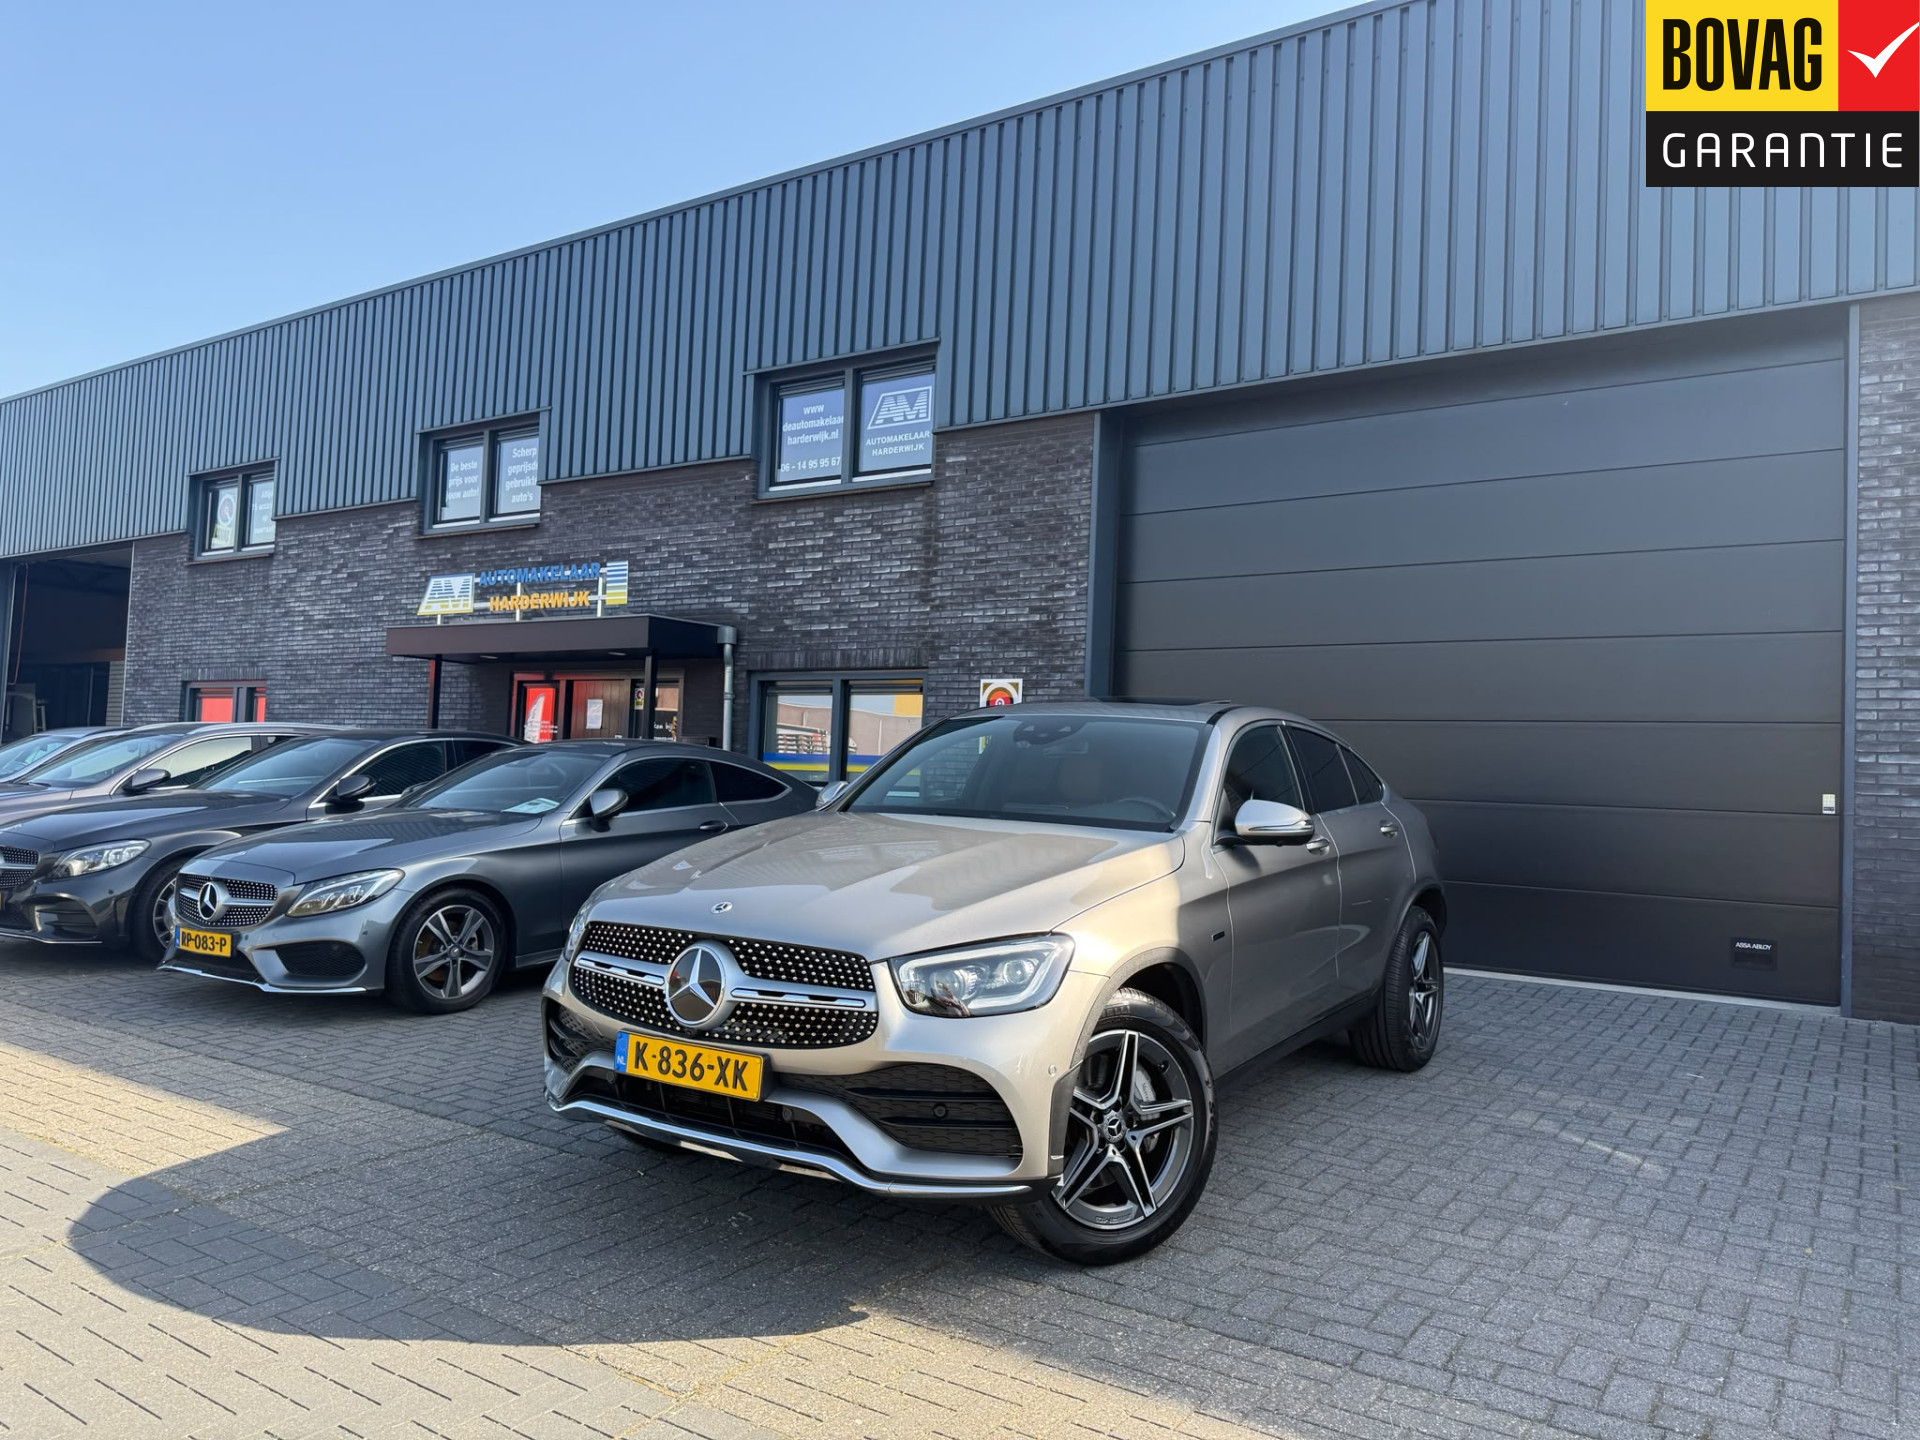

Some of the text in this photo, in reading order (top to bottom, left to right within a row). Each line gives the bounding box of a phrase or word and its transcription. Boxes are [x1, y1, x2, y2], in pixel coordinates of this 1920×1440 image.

[803, 404, 825, 415] www
[787, 429, 839, 446] harderwijk.nl
[866, 431, 930, 446] AUTOMAKELAAR
[512, 447, 537, 459] Scherp
[871, 443, 925, 456] HARDERWIJK
[797, 460, 807, 470] 14
[808, 459, 818, 469] 95
[820, 458, 829, 468] 95
[478, 562, 601, 587] AUTOMAKELAAR
[489, 591, 591, 612] HARDERWIJK
[181, 931, 227, 952] RP-083-P
[634, 1041, 748, 1091] K-836-XK
